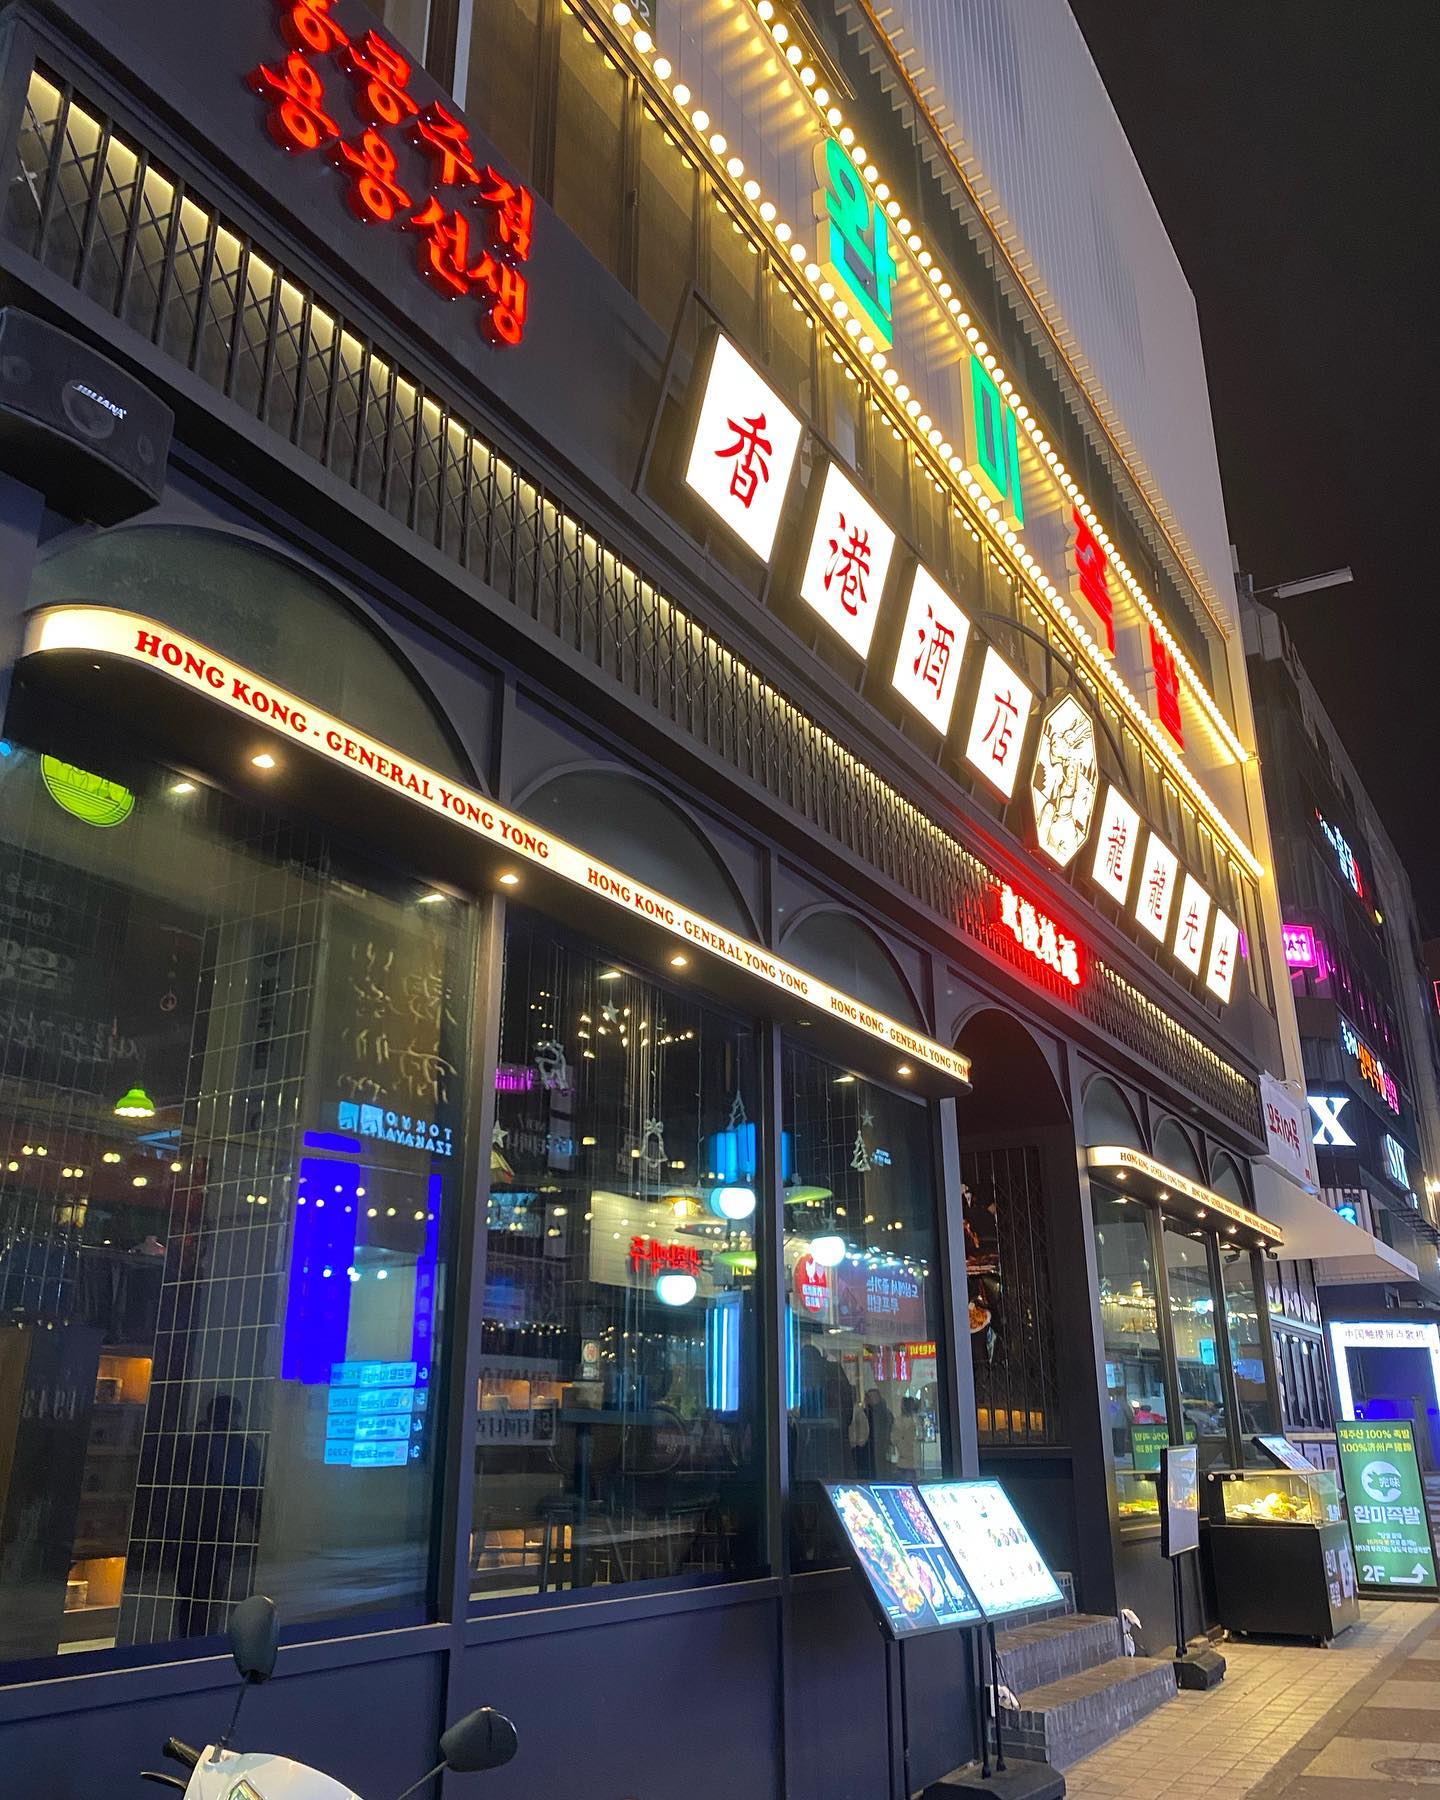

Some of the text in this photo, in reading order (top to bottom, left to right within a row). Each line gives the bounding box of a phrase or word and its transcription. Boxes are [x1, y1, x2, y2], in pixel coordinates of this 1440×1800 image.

[258, 50, 528, 345] 용용선생
[134, 630, 226, 690] HONG
[231, 678, 308, 735] KONG
[326, 729, 435, 801] GENERAL
[438, 787, 494, 831] YONG
[499, 818, 549, 859] YONG
[587, 867, 632, 902] HONG
[634, 891, 675, 926] KONG
[683, 919, 743, 961] GENERAL
[744, 950, 776, 978] YONG
[779, 969, 808, 995] YONG
[830, 995, 857, 1020] HONG
[859, 1011, 884, 1034] KONG
[890, 1028, 929, 1058] GENERAL
[929, 1048, 951, 1069] YONG
[1365, 1429, 1392, 1439] 100%
[1353, 1504, 1421, 1526] 완미족발
[1362, 1564, 1386, 1583] 2F
